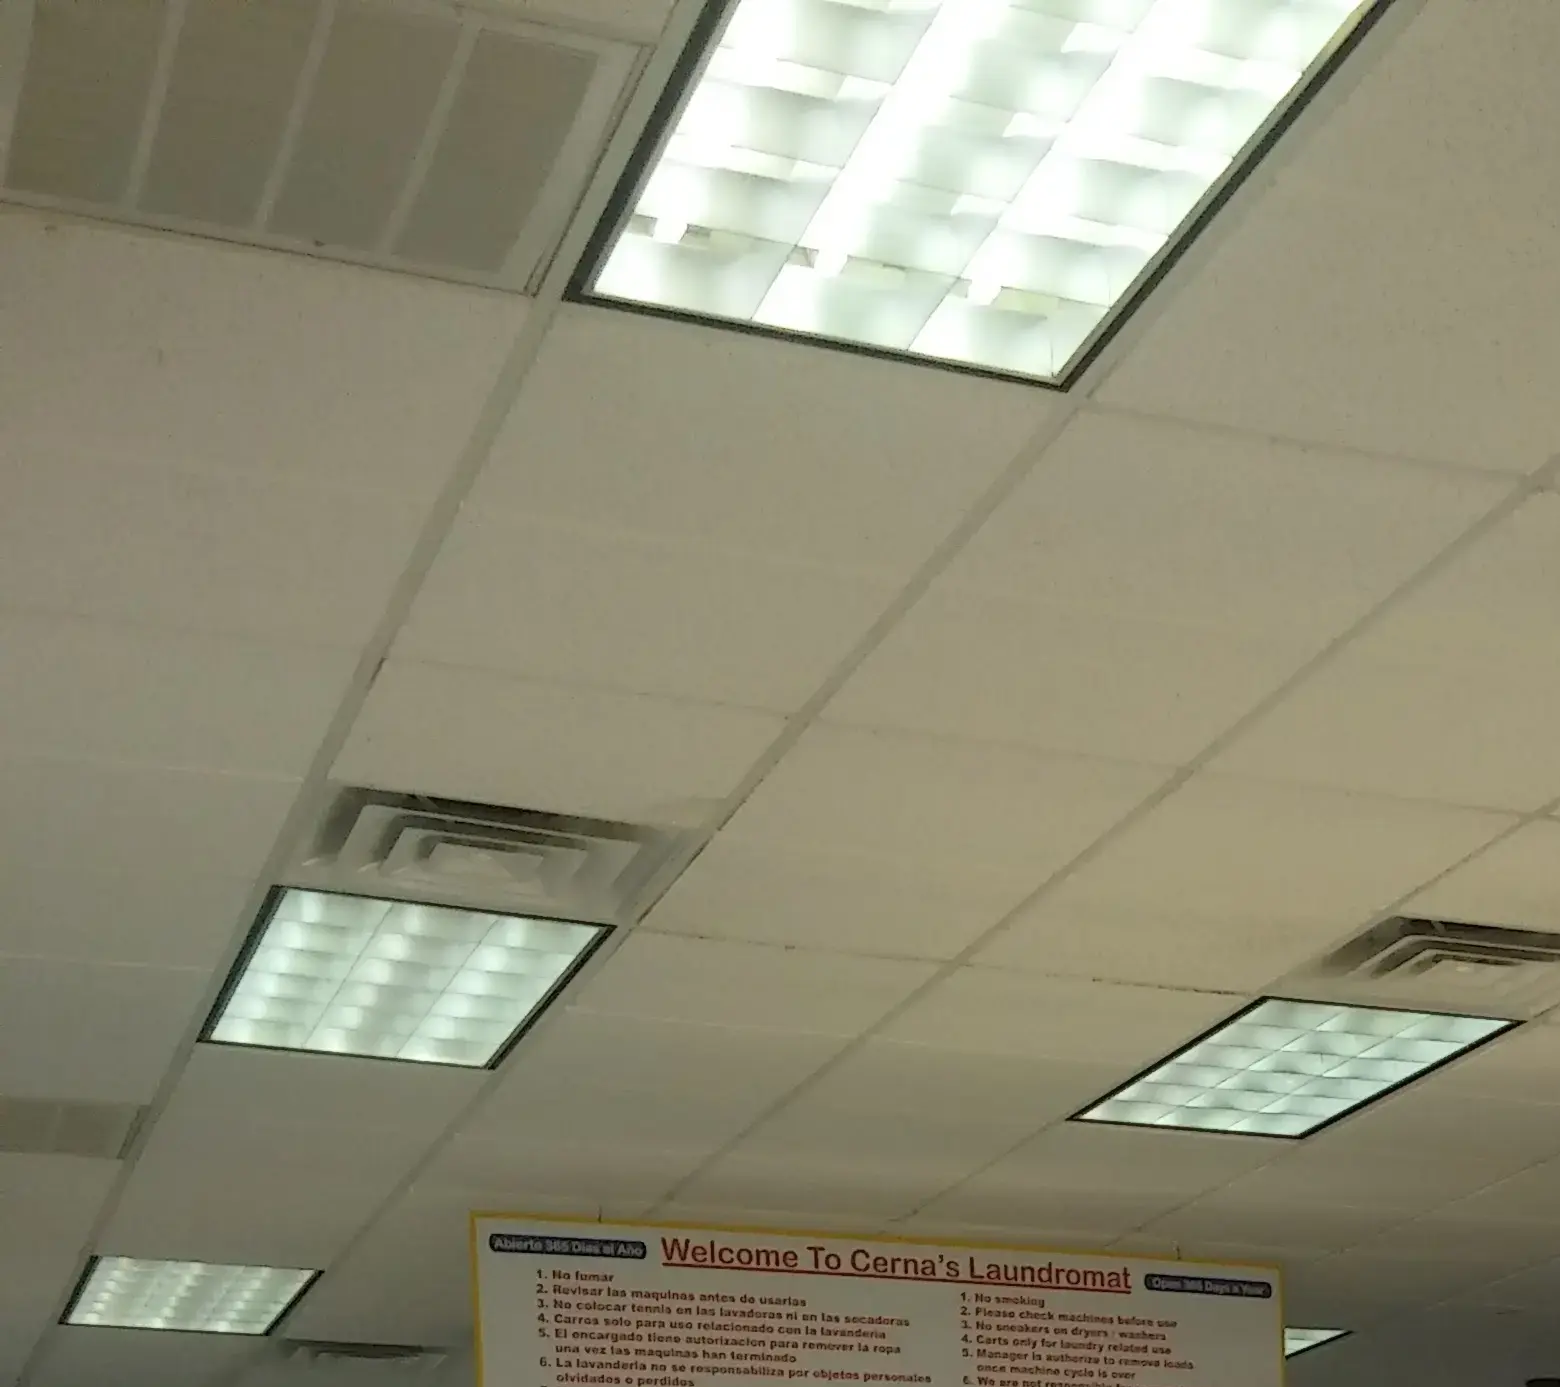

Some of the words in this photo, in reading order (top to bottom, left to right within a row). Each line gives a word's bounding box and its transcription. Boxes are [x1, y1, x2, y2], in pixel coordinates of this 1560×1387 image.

[660, 1236, 798, 1269] Welcome
[806, 1245, 842, 1271] To
[849, 1247, 960, 1278] Cerna's
[967, 1255, 1131, 1288] Laundromat
[551, 1269, 571, 1280] No
[574, 1270, 614, 1282] fumar
[605, 1286, 627, 1298] las
[629, 1288, 695, 1303] maquinas
[698, 1292, 736, 1303] antes
[739, 1294, 755, 1305] de
[552, 1298, 572, 1309] No
[574, 1299, 627, 1312] colocar
[675, 1306, 693, 1315] en
[695, 1306, 716, 1317] las
[718, 1307, 783, 1320] lavadoras
[784, 1311, 798, 1321] ni
[800, 1313, 817, 1322] en
[820, 1312, 840, 1323] las
[843, 1314, 910, 1327] secadoras
[553, 1313, 600, 1325] Carros
[603, 1315, 632, 1327] solo
[634, 1319, 666, 1331] para
[667, 1320, 693, 1330] uso
[696, 1320, 774, 1334] relacionado
[776, 1326, 802, 1335] con
[803, 1326, 817, 1336] la
[554, 1327, 568, 1338] El
[646, 1332, 681, 1344] tiene
[769, 1340, 799, 1351] para
[801, 1341, 854, 1352] remover
[856, 1342, 869, 1353] la
[872, 1345, 901, 1356] ropa
[554, 1344, 580, 1353] una
[583, 1345, 607, 1355] vez
[609, 1345, 630, 1356] las
[633, 1346, 699, 1361] maquinas
[701, 1349, 727, 1360] han
[729, 1350, 796, 1363] terminado
[555, 1357, 572, 1367] La
[649, 1363, 667, 1372] no
[670, 1364, 686, 1373] se
[689, 1363, 784, 1379] responsabiliza
[787, 1369, 809, 1380] por
[812, 1368, 859, 1382] objetos
[862, 1371, 931, 1386] personales
[555, 1371, 621, 1384] olvidados
